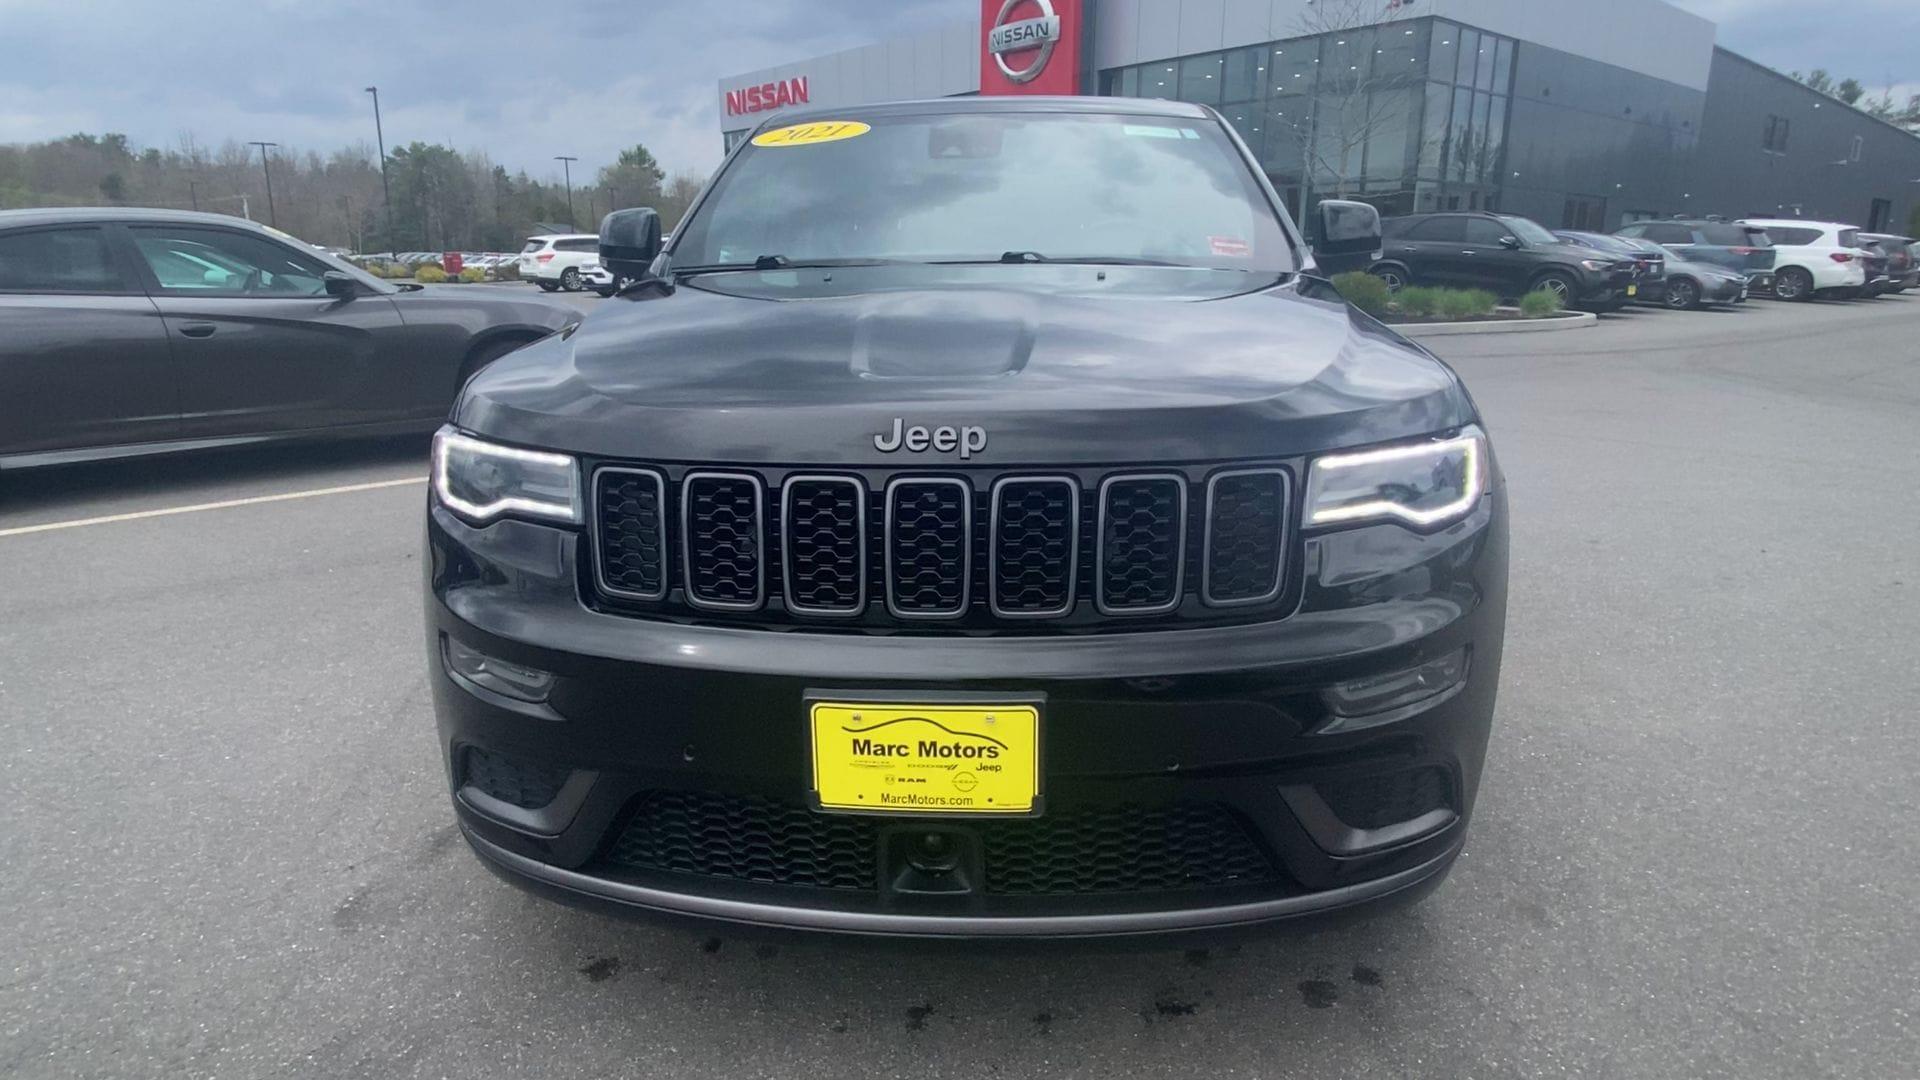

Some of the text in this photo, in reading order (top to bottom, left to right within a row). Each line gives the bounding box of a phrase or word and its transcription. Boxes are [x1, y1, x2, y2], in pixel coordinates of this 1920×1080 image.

[992, 22, 1049, 46] NISSAN
[726, 75, 809, 117] NISSAN
[768, 124, 852, 143] 2021
[873, 418, 988, 460] Jeep
[852, 738, 999, 759] Marc Motors
[975, 762, 1002, 773] Jeep
[880, 793, 974, 806] MarcMotors.com
